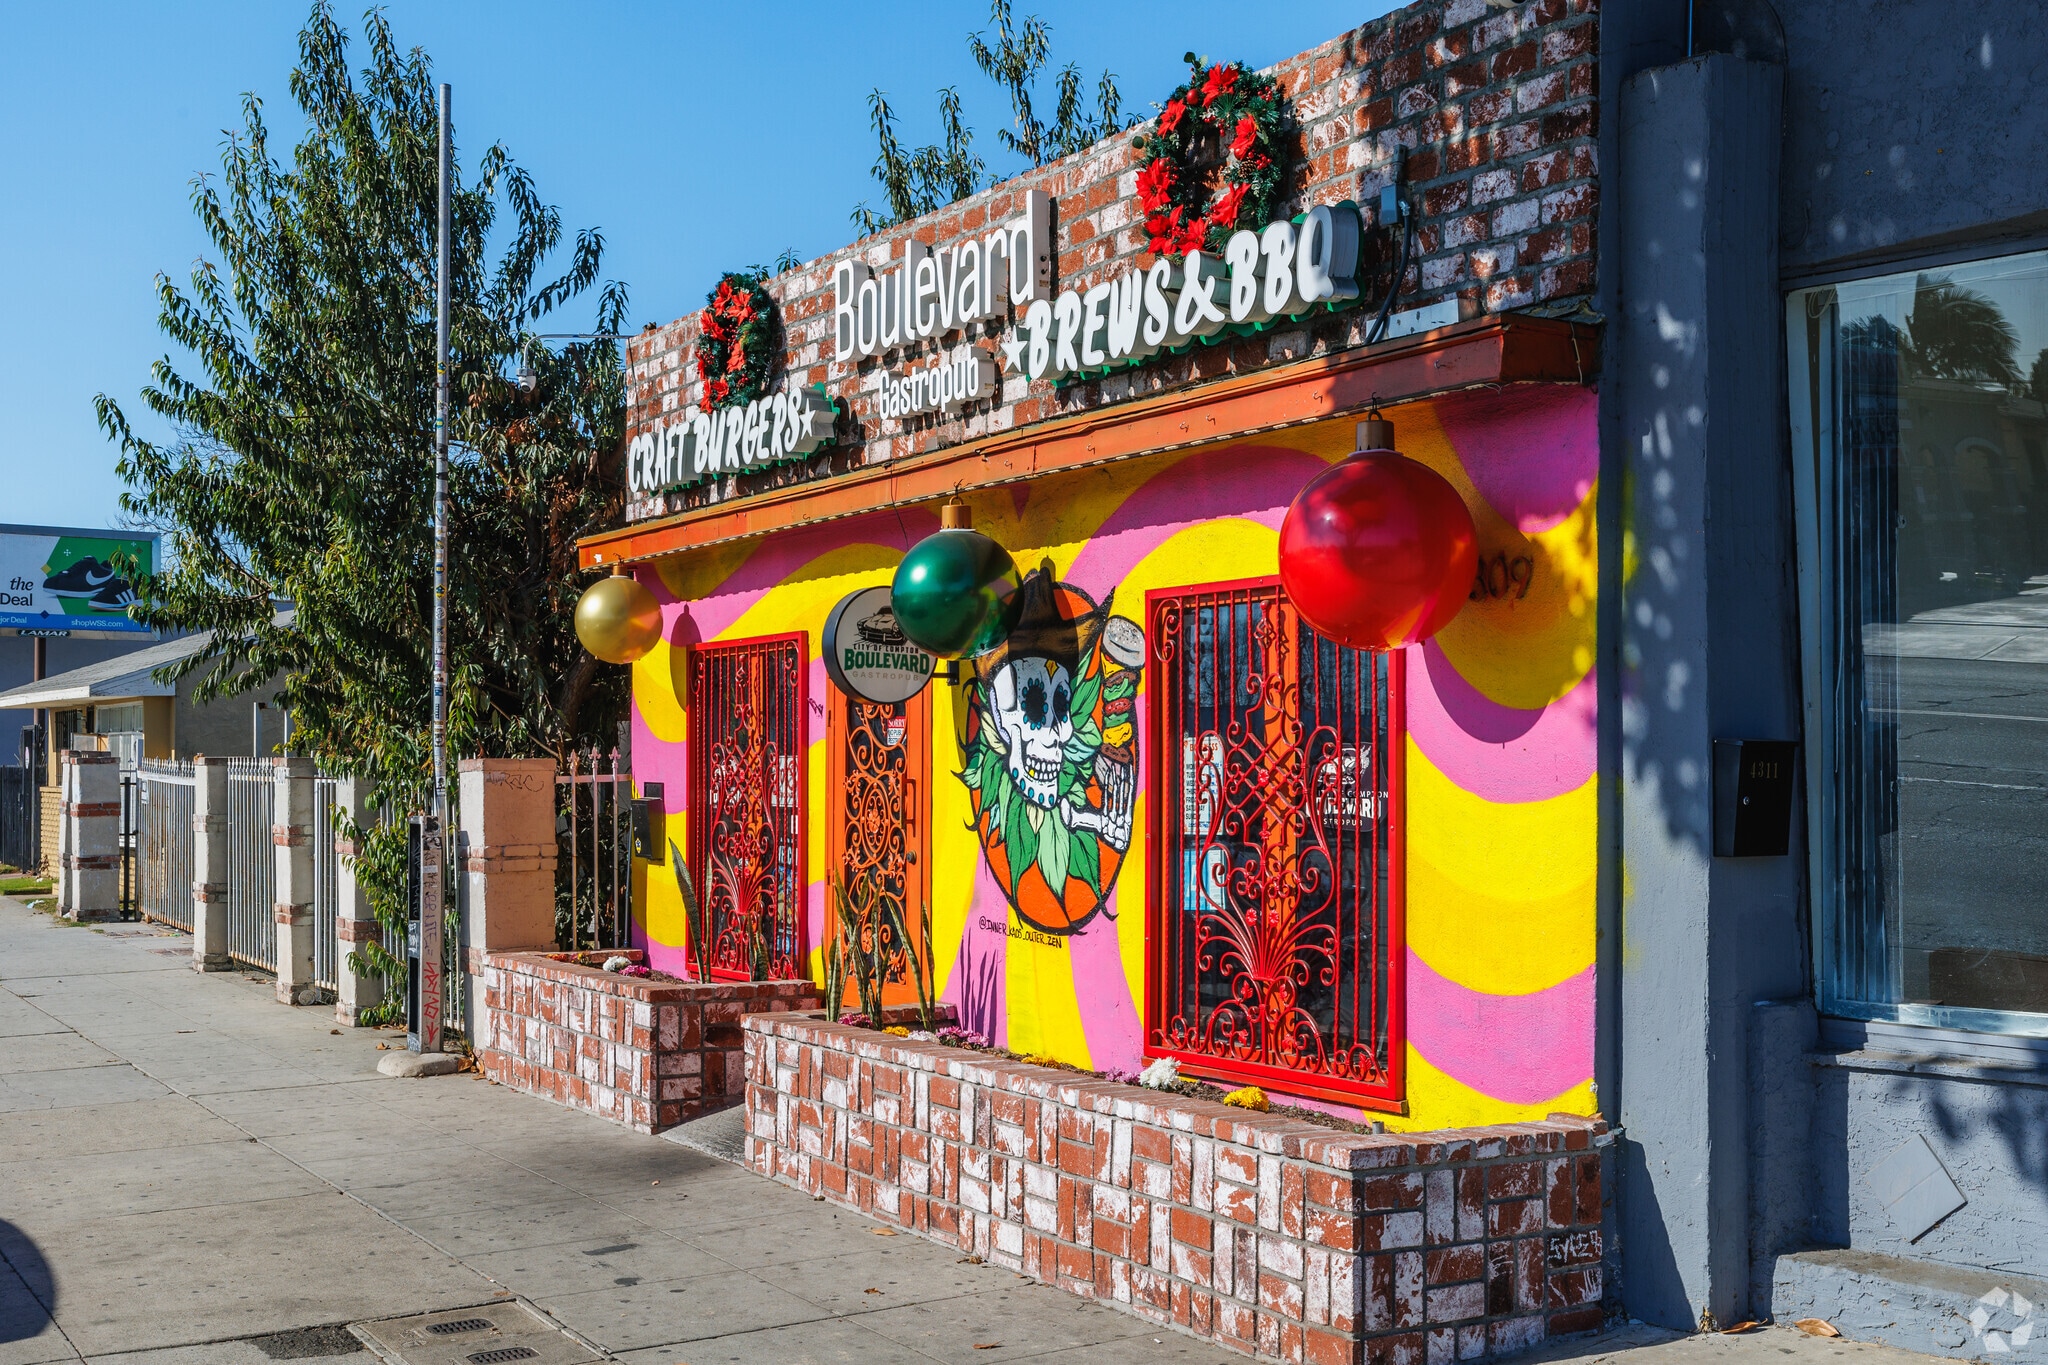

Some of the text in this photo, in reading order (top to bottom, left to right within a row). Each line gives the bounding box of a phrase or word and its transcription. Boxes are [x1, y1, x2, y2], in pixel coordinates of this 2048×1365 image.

[833, 190, 1036, 364] Boulevard
[879, 346, 979, 420] Gastropub
[628, 387, 802, 493] CRAFT BURGERS
[10, 576, 34, 591] the
[0, 592, 33, 607] Deal
[10, 616, 28, 624] Deal
[71, 619, 124, 628] shopWSS.com
[20, 629, 68, 637] LAMAR
[853, 643, 871, 651] CITY
[885, 645, 919, 654] COMPTON
[844, 648, 930, 676] BOULEVARD
[851, 671, 920, 682] GASTROPUB
[1750, 761, 1779, 779] 4311
